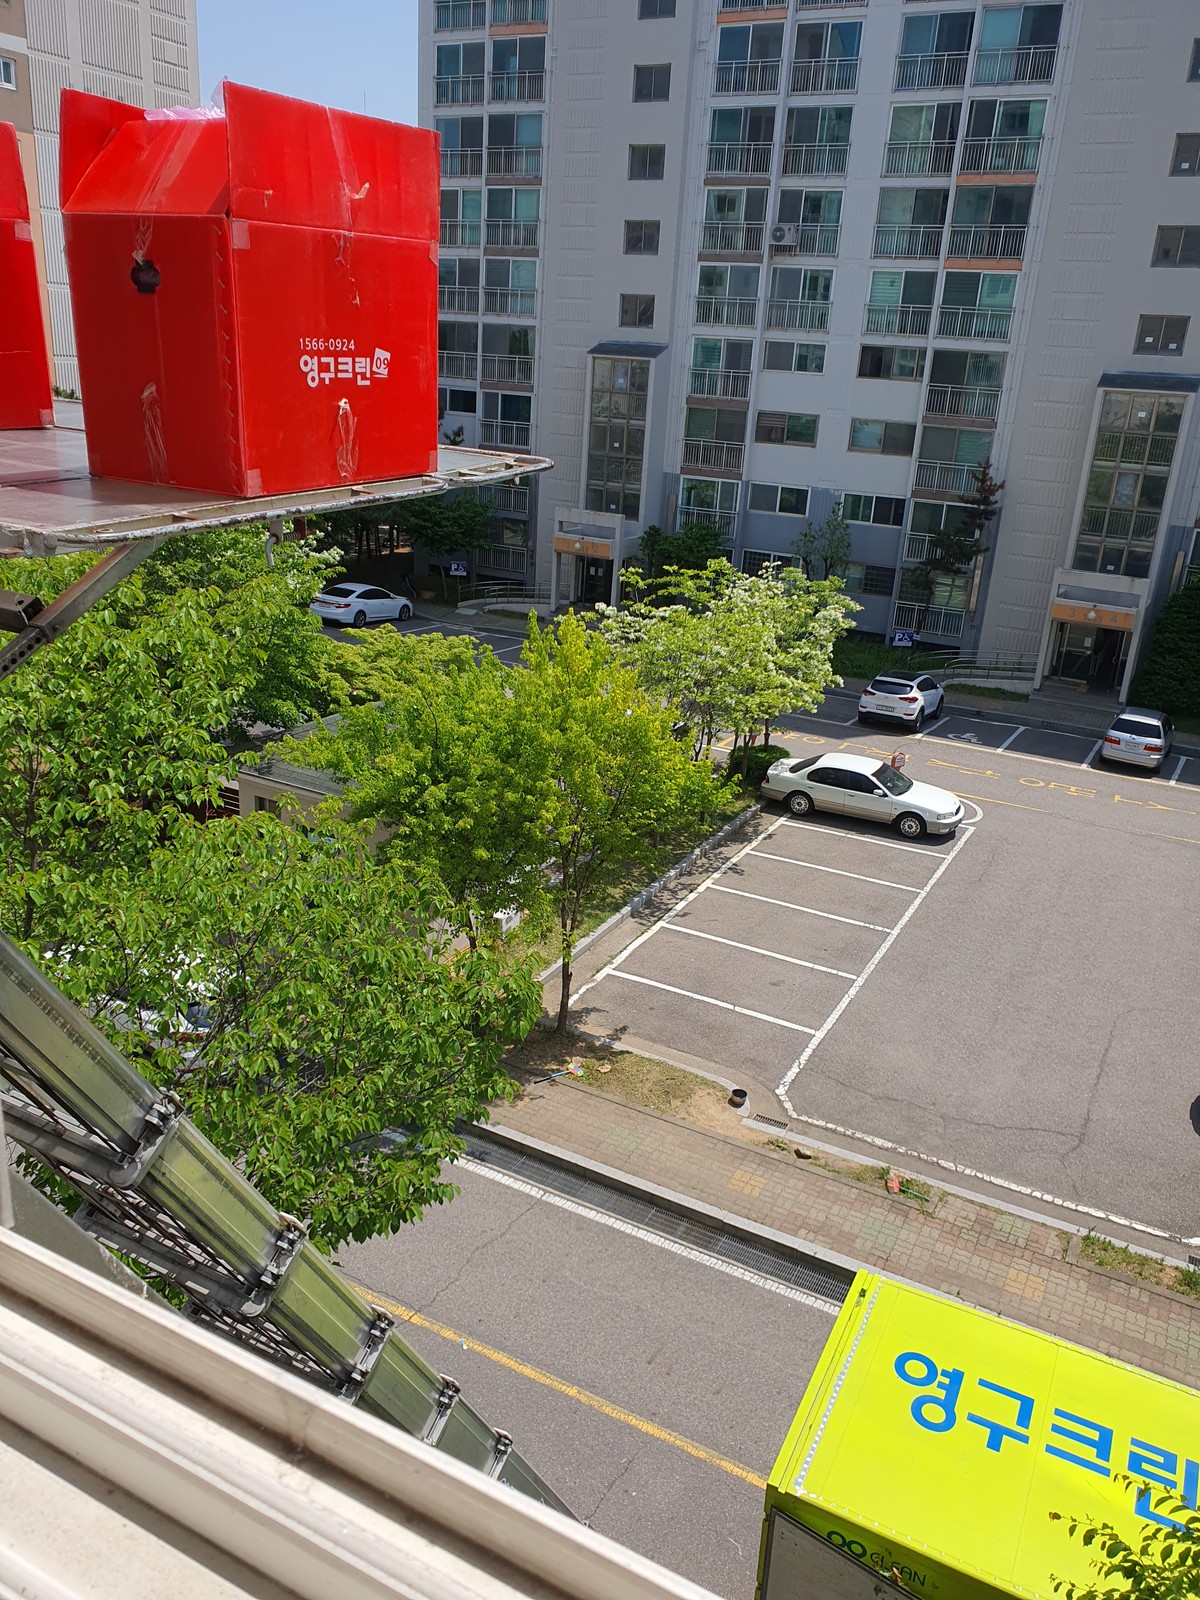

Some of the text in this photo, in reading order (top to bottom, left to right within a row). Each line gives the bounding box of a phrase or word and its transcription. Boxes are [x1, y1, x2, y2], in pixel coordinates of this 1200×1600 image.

[299, 338, 355, 351] 1566-0924
[300, 354, 371, 388] 영구크린
[893, 1351, 1200, 1534] 영구크린
